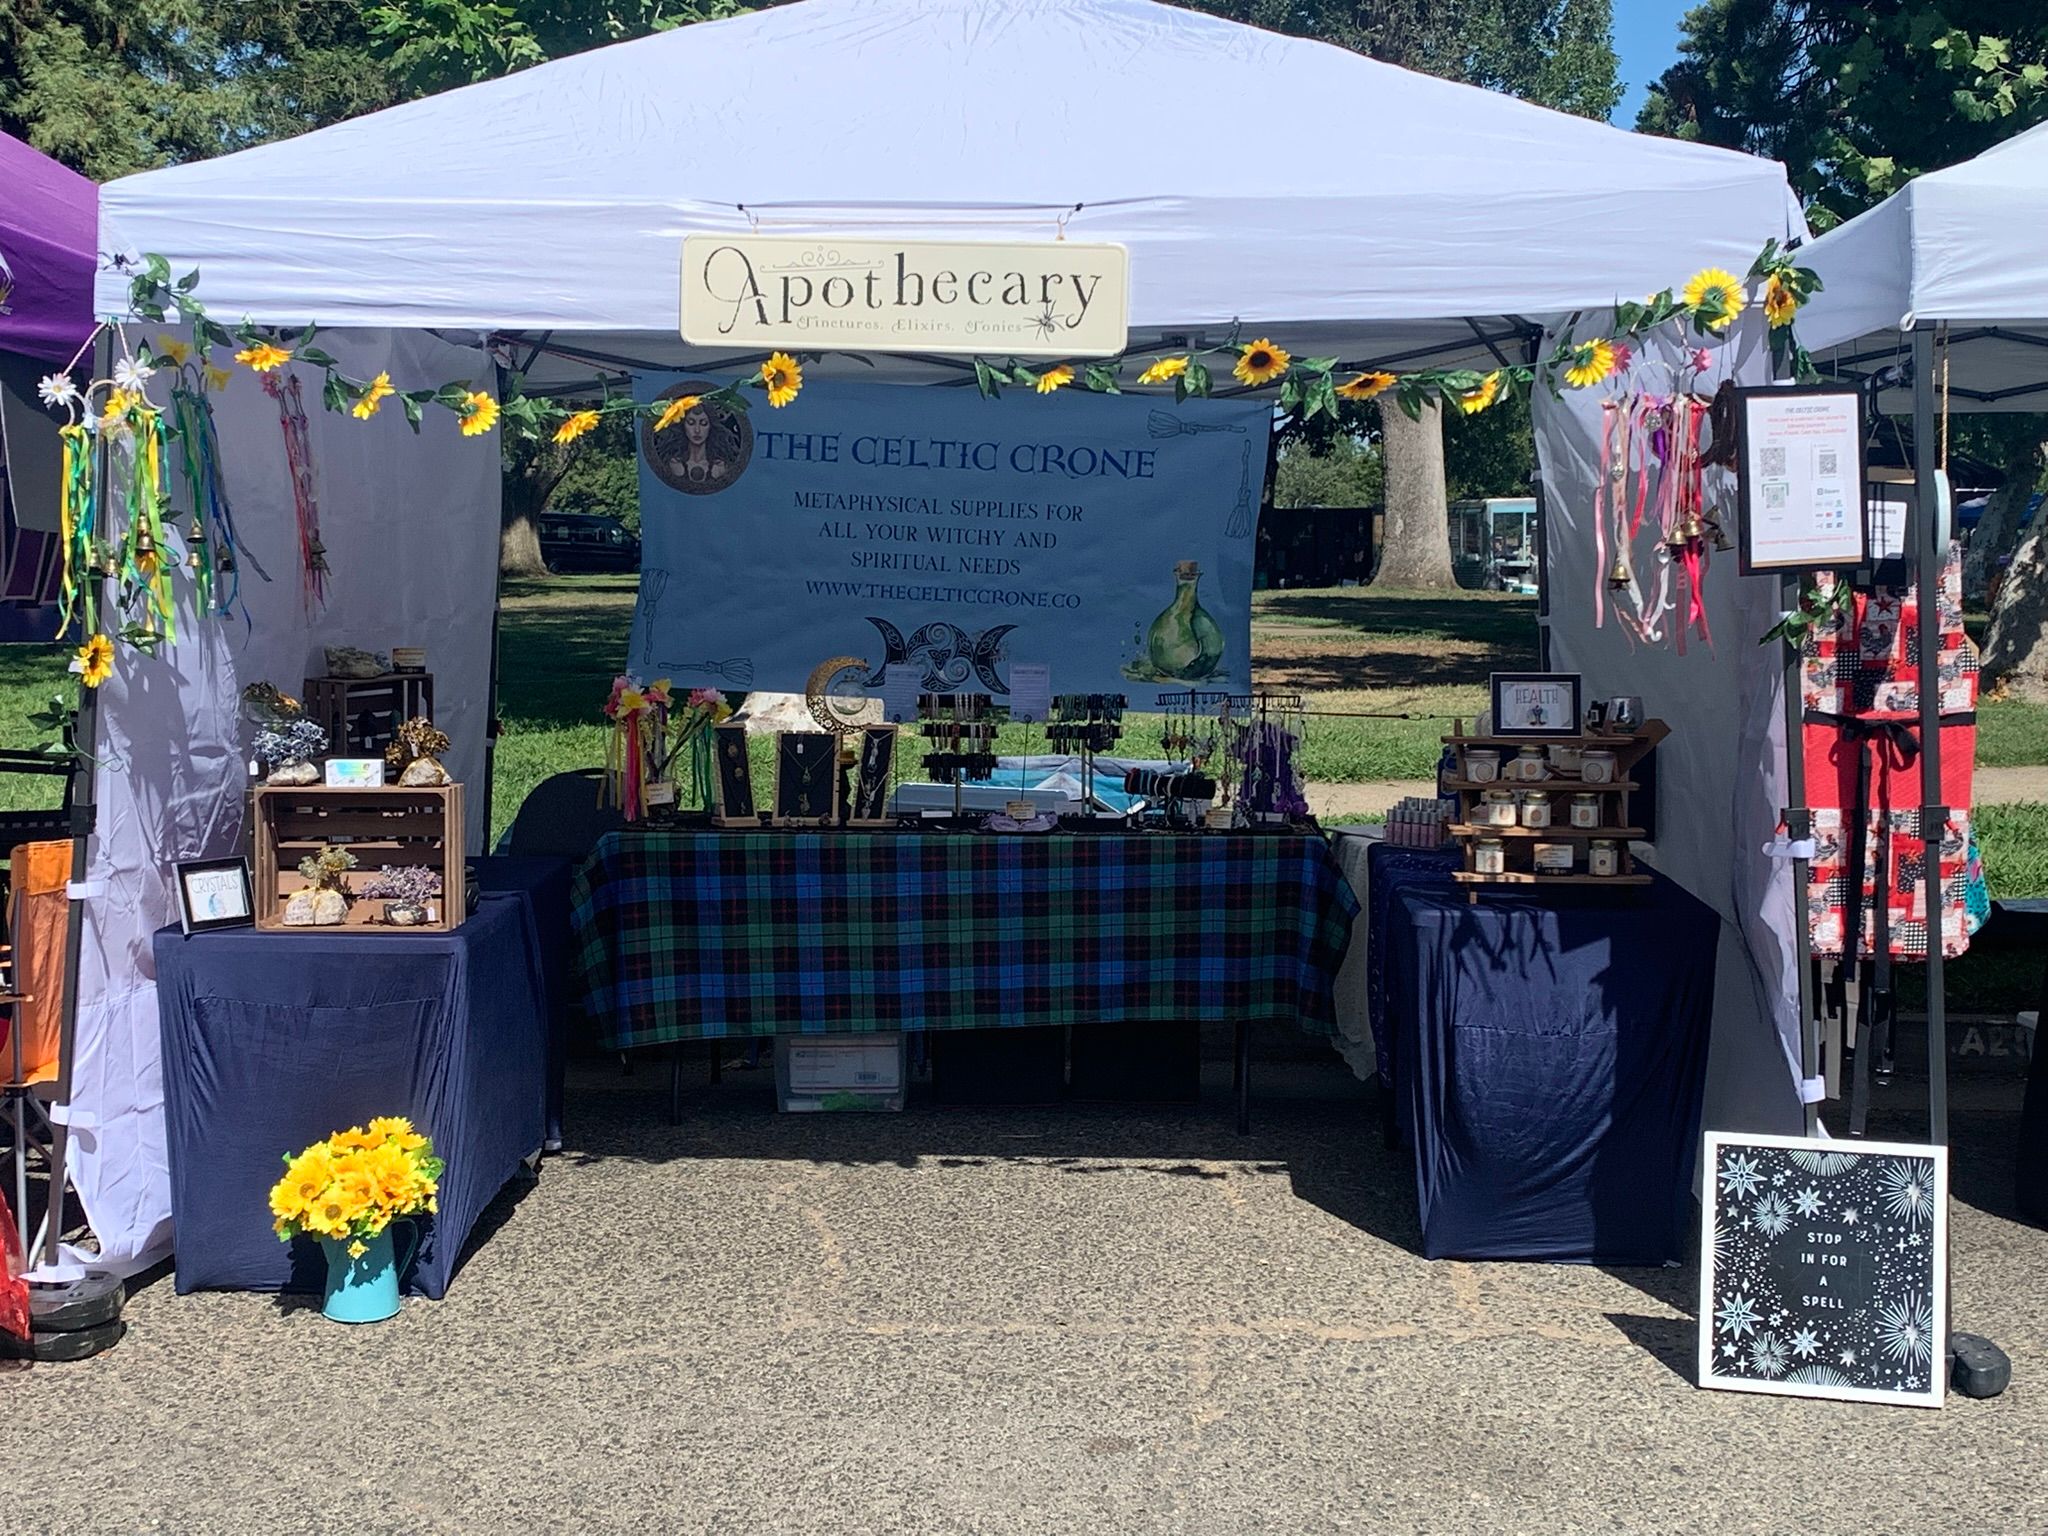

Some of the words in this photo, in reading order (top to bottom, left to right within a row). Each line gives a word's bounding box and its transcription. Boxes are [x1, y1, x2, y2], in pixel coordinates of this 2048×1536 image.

[703, 245, 1102, 334] Apothecary
[756, 430, 842, 463] THE
[851, 435, 1002, 471] CELTIC
[1009, 443, 1160, 480] CRONE
[794, 491, 943, 516] METAPHYSICAL
[950, 499, 1038, 520] SUPPLIES
[1046, 504, 1084, 522] FOR
[819, 521, 857, 539] ALL
[864, 523, 917, 542] YOUR
[926, 526, 1006, 546] WITCHY
[1013, 530, 1057, 549] AND
[851, 551, 951, 573] SPIRITUAL
[959, 556, 1021, 576] NEEDS
[806, 580, 1081, 609] WWW.THECELTICCRONE.CO
[1515, 688, 1559, 705] HEALTH
[190, 871, 240, 894] CRYSTALS
[1807, 1231, 1843, 1244] STOP
[1800, 1252, 1815, 1265] IN
[1821, 1254, 1848, 1267] FOR
[1819, 1275, 1828, 1287] A
[1802, 1295, 1845, 1310] SPELL
